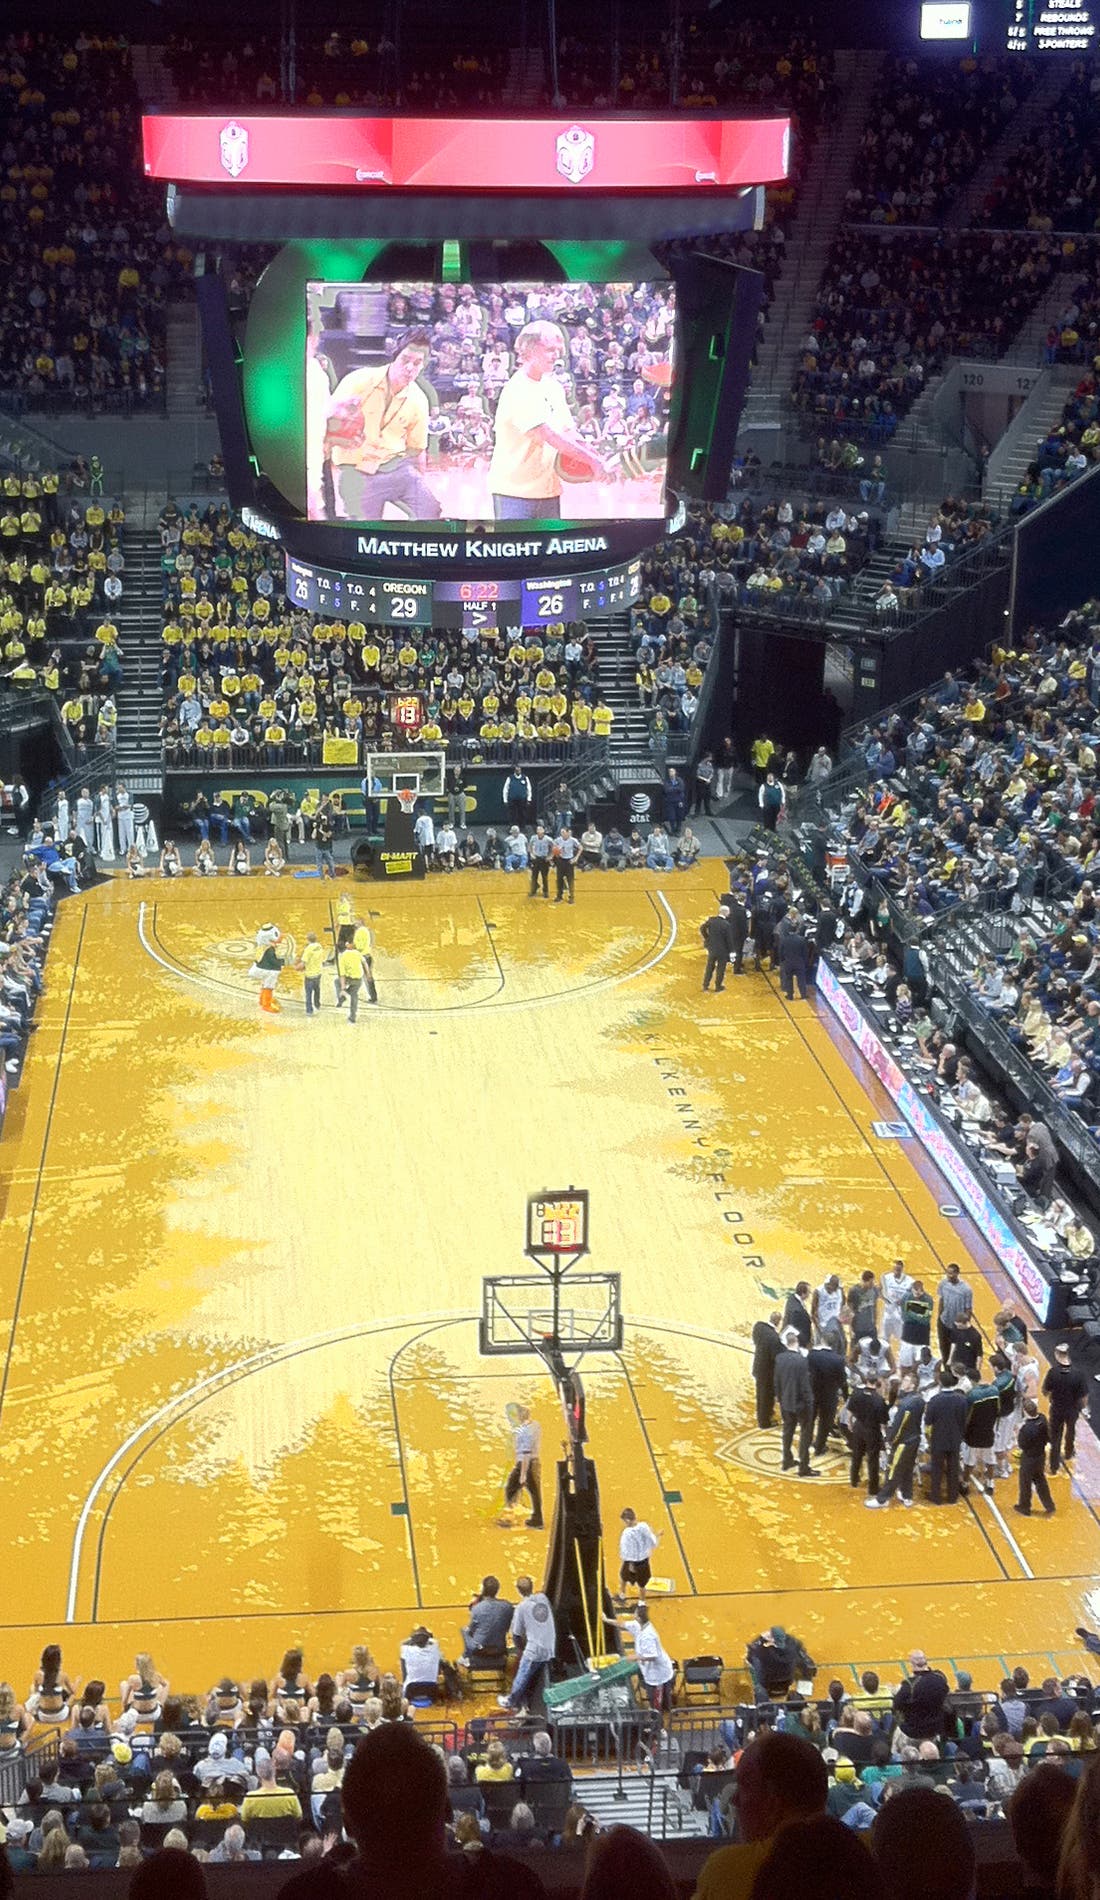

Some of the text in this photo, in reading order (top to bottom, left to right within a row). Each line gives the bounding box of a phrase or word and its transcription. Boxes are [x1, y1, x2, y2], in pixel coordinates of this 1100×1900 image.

[1040, 12, 1089, 22] REBOUNDS
[1034, 26, 1056, 36] FREE
[1058, 26, 1095, 36] THROWS
[963, 374, 984, 386] 120
[357, 536, 607, 558] MATTHEW KNIGHT ARENA
[346, 583, 376, 597] T.O. 4
[382, 583, 427, 595] OREGON
[526, 579, 572, 591] Washington
[579, 582, 596, 594] T.O.
[460, 583, 498, 600] 6:22
[350, 600, 376, 613] F. 4
[391, 597, 417, 618] 29
[463, 601, 488, 611] HALF
[538, 594, 564, 616] 26
[400, 706, 416, 724] 13
